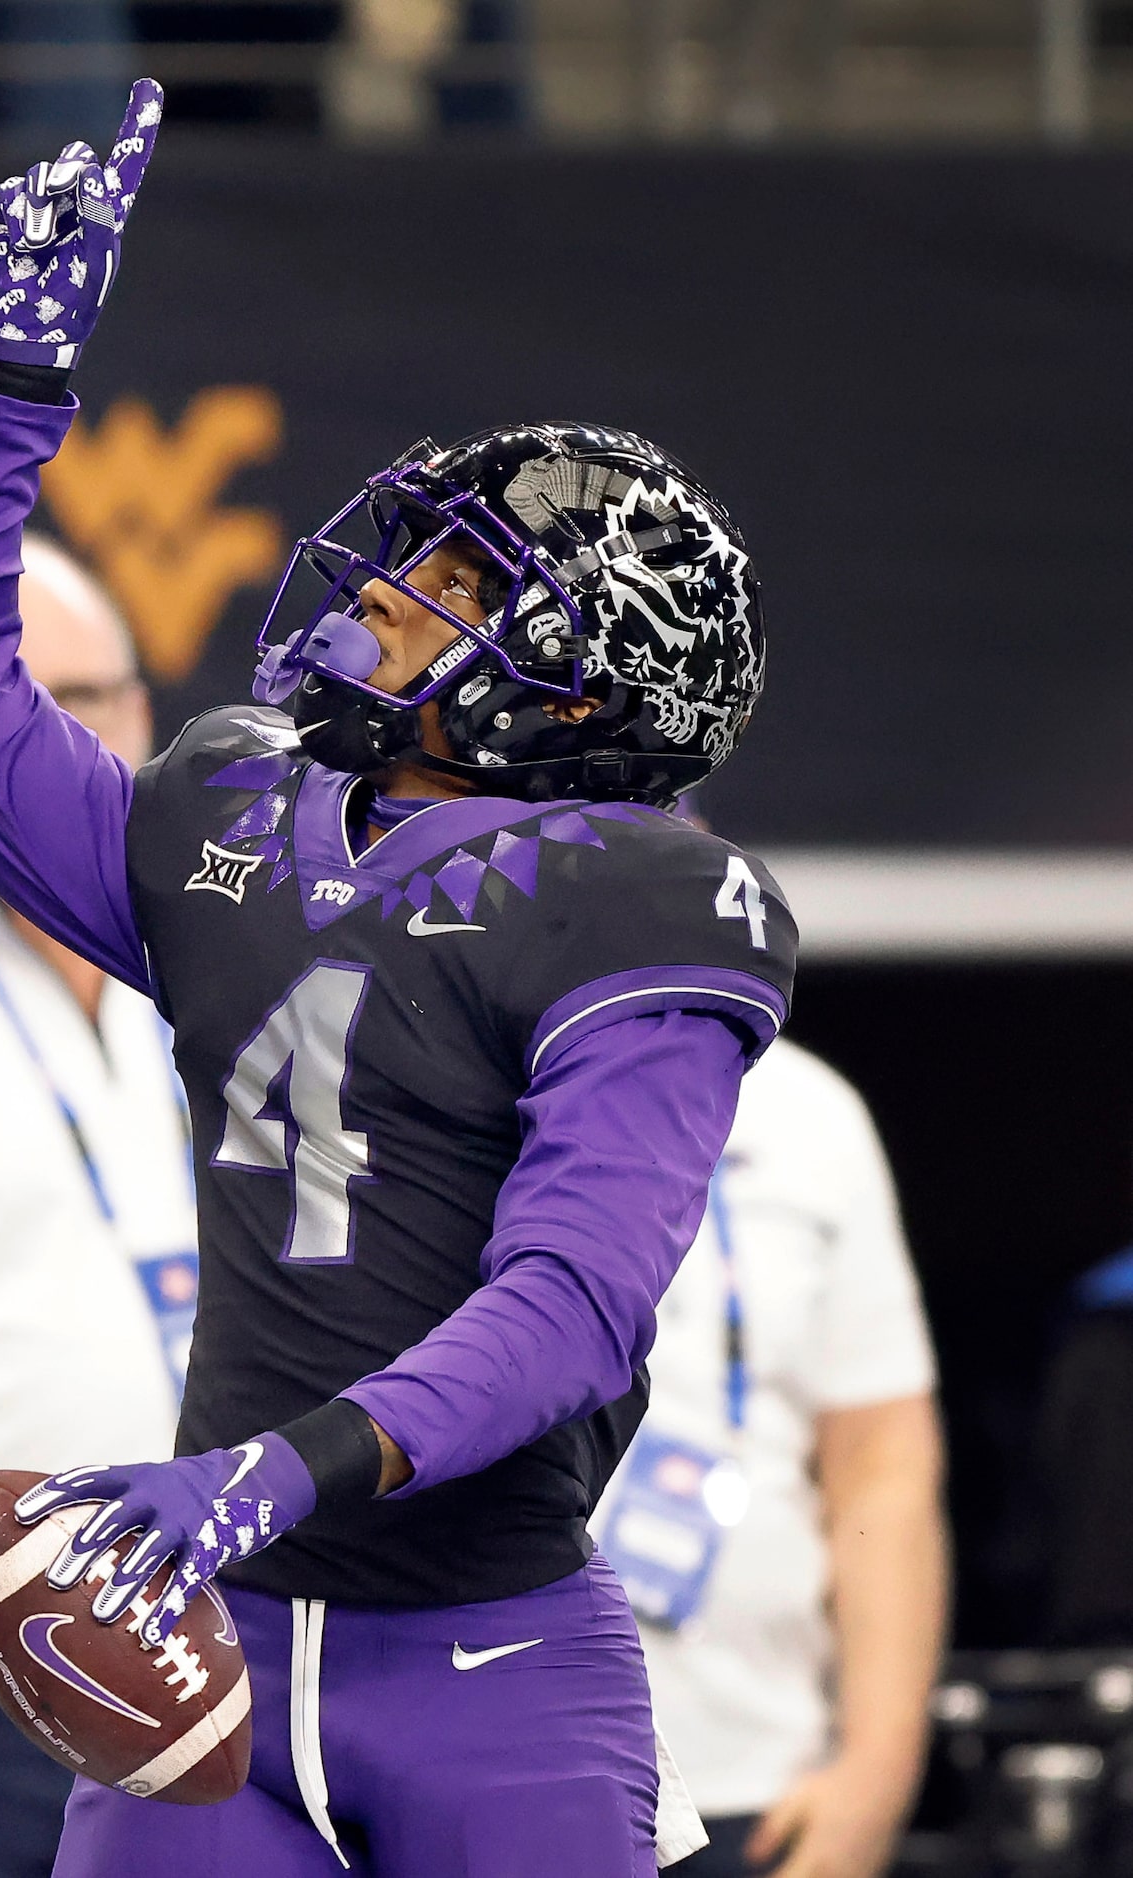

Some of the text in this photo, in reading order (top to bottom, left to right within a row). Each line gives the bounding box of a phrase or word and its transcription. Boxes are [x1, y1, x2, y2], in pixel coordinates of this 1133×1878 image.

[309, 878, 357, 907] TCU
[713, 855, 769, 949] 4
[210, 957, 381, 1264] 4
